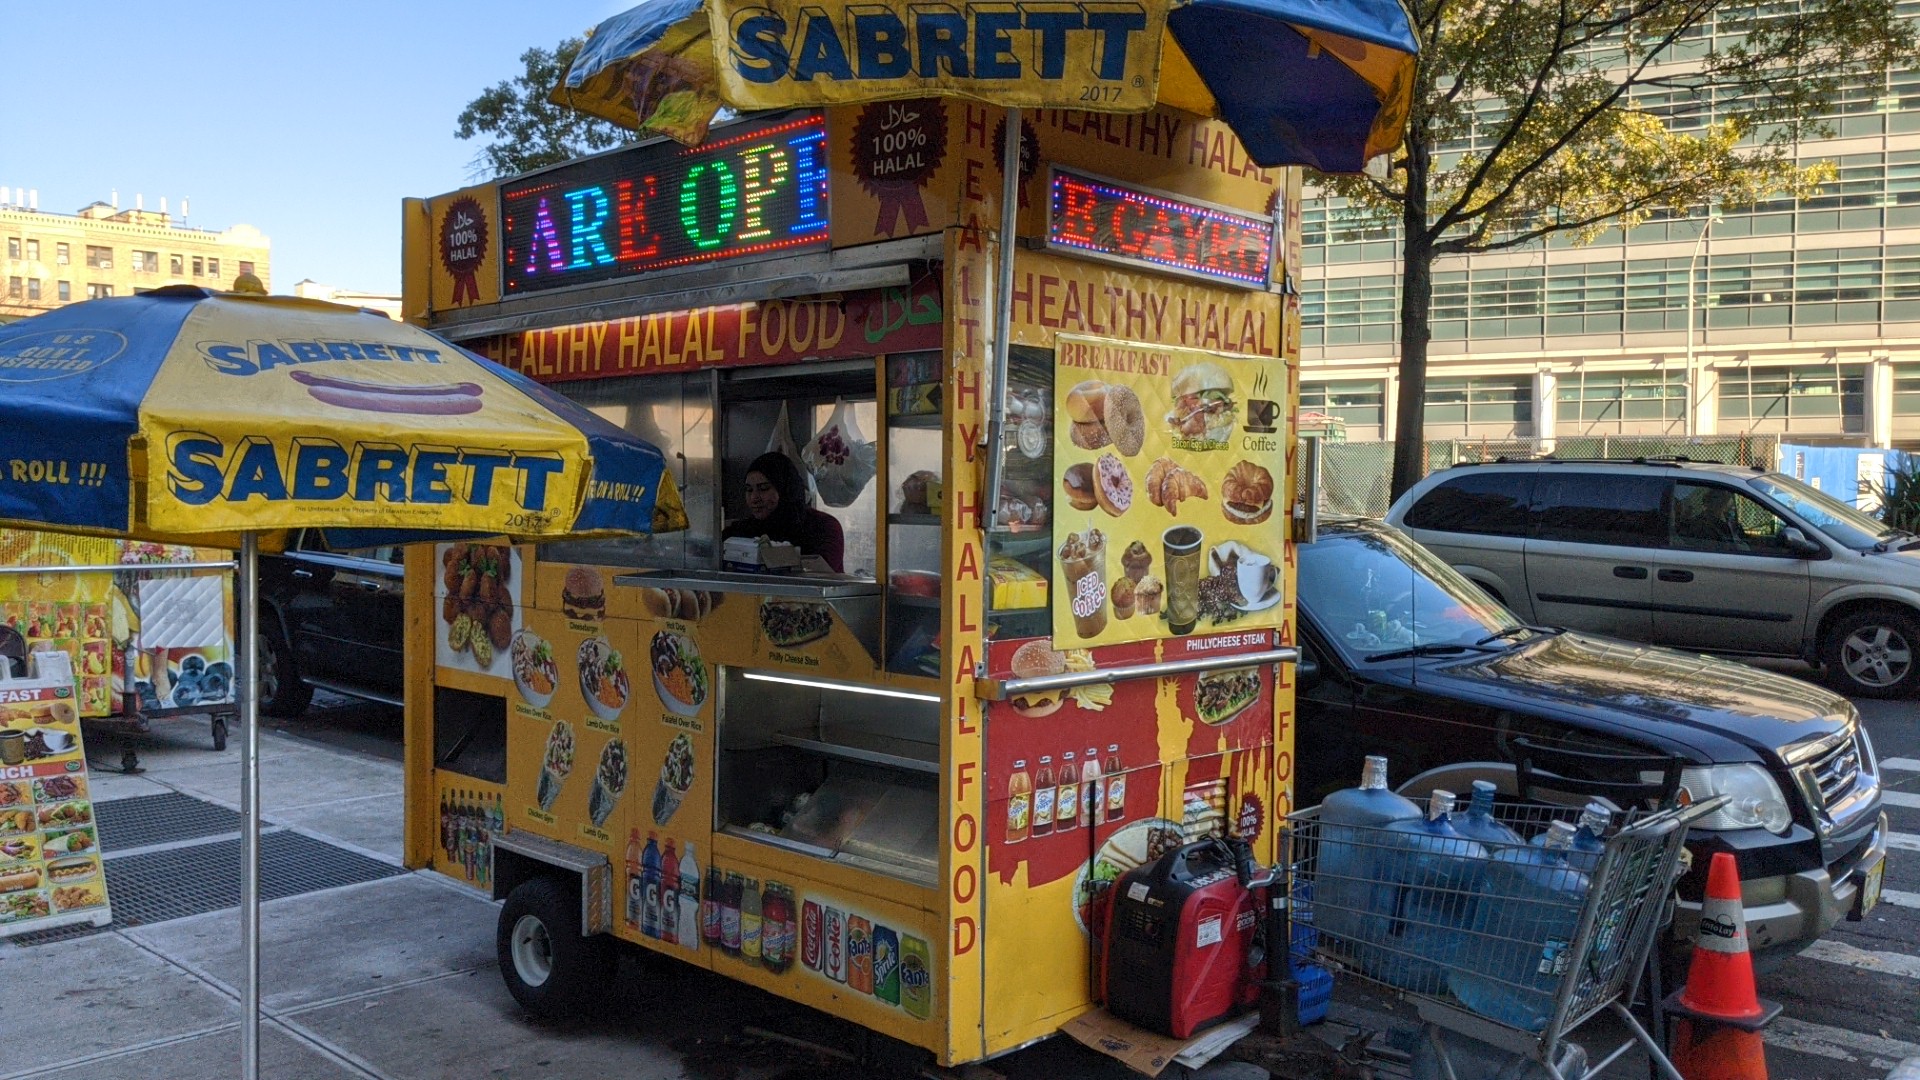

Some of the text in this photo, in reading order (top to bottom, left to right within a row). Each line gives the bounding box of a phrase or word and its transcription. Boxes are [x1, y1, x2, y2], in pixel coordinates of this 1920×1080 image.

[729, 1, 1147, 84] SABRETT
[1079, 85, 1123, 103] 2017
[872, 127, 927, 155] 100%
[873, 152, 926, 176] HALAL
[526, 175, 661, 273] ARE
[450, 229, 477, 248] 100%
[450, 246, 478, 261] HALAL
[957, 104, 987, 463] HEALTHY
[1010, 269, 1273, 355] HEALTHY HALAL
[487, 296, 847, 376] HEALTHY HALAL FOOD
[196, 338, 444, 376] SABRETT
[1059, 343, 1171, 377] BREAKFAST
[1171, 437, 1190, 449] Bacon
[1190, 438, 1202, 451] Egg
[1243, 436, 1276, 451] Coffee
[10, 459, 70, 484] ROLL
[164, 430, 566, 507] SABRETT
[1077, 571, 1098, 598] ICED
[956, 491, 979, 735] HALAL
[1242, 632, 1266, 646] STEAK
[953, 762, 978, 957] FOOD
[630, 878, 640, 900] G
[646, 883, 657, 907] G
[663, 889, 675, 912] G
[874, 951, 896, 985] Sprite
[900, 960, 930, 986] Fanta
